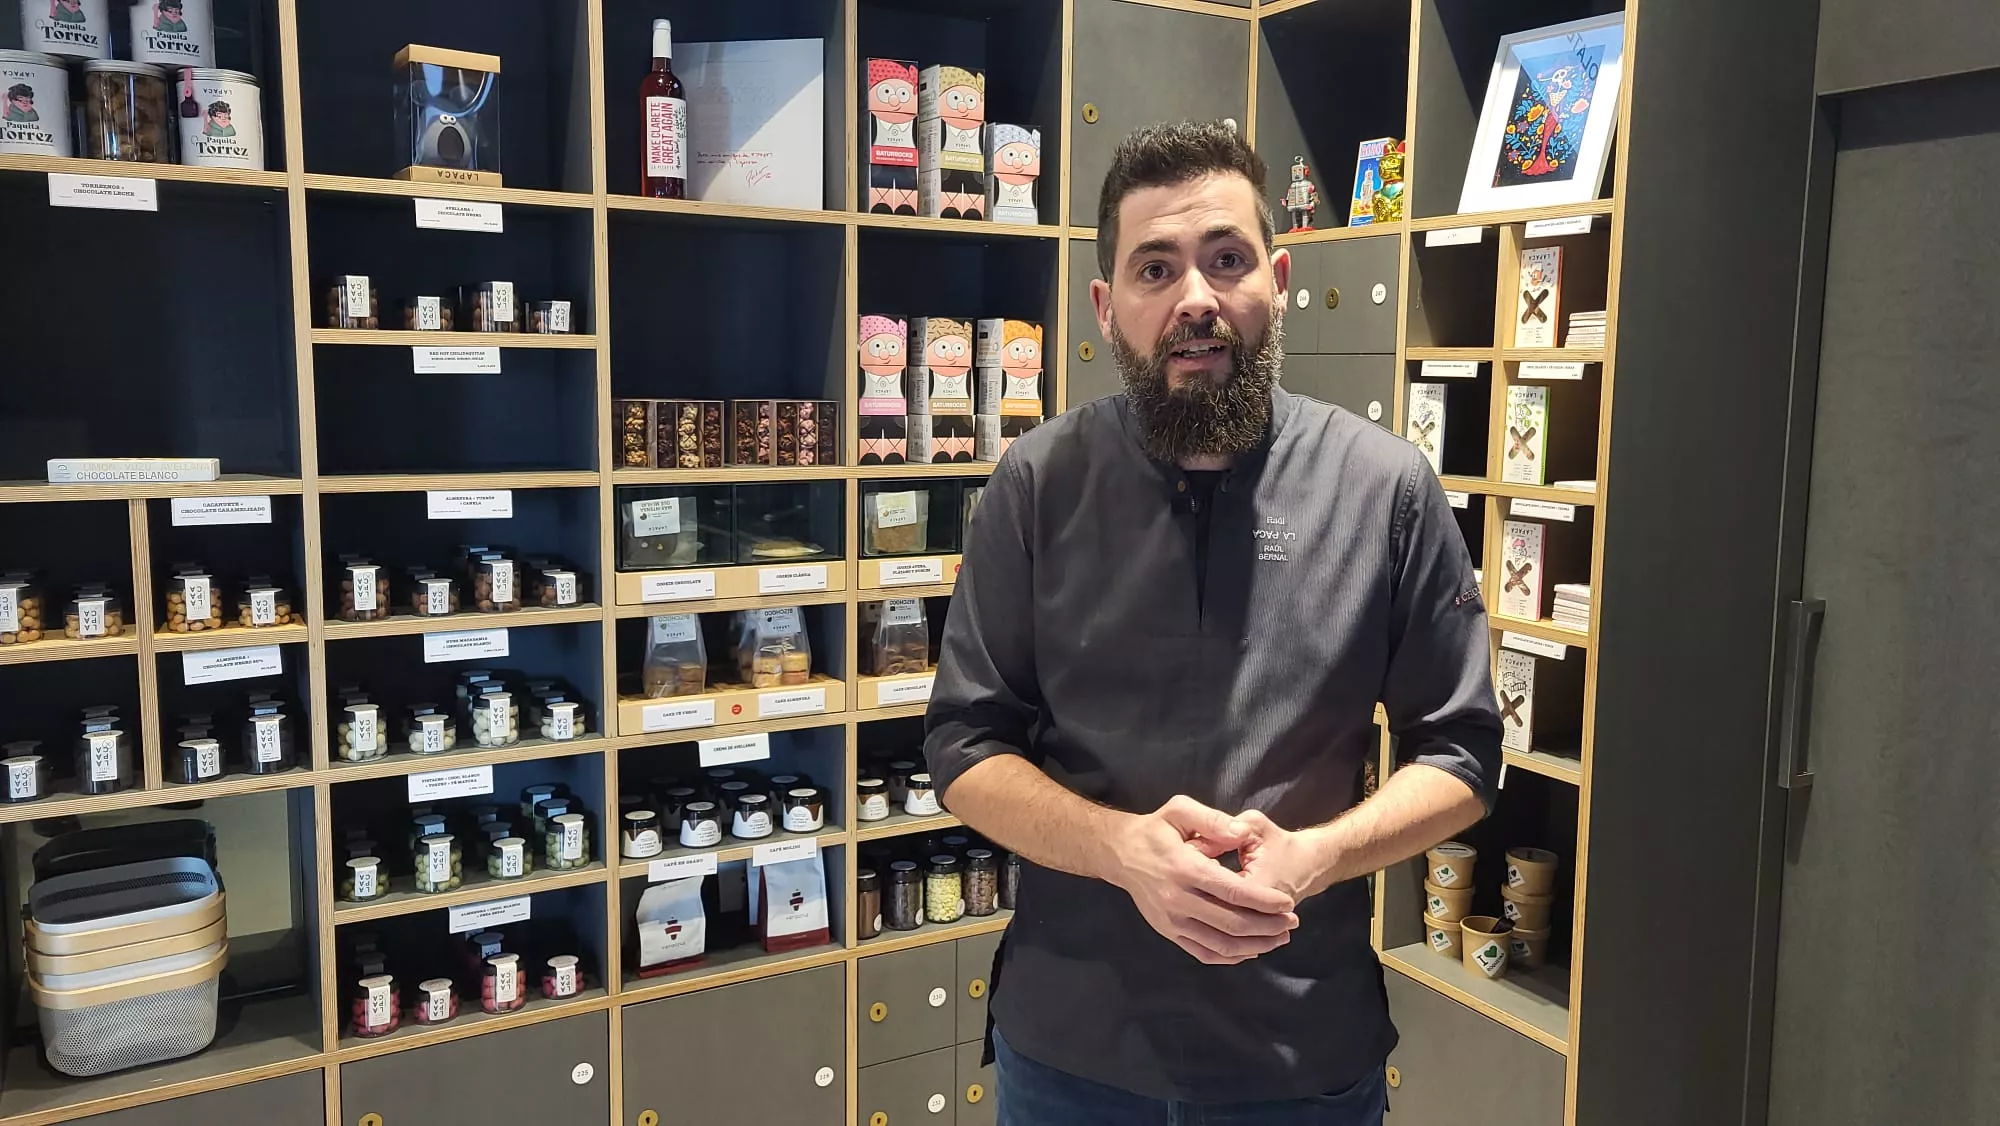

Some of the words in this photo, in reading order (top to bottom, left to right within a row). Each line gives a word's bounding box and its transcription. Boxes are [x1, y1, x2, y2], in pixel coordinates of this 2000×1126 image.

[53, 21, 86, 31] Paquita
[41, 26, 98, 45] Torrez
[157, 31, 188, 41] Paquita
[146, 37, 200, 54] Torrez
[651, 102, 660, 139] CLARETE
[662, 103, 673, 132] AGAIN
[6, 122, 40, 130] Paquita
[207, 136, 236, 145] Paquita
[196, 142, 249, 156] Torrez
[651, 142, 661, 164] MAKE
[662, 134, 673, 164] GREAT
[437, 170, 479, 181] LAPACA
[76, 472, 136, 480] CHOCOLATE
[138, 472, 178, 480] BLANCO
[1264, 544, 1284, 552] RAÚL
[1258, 554, 1288, 562] BERNAL
